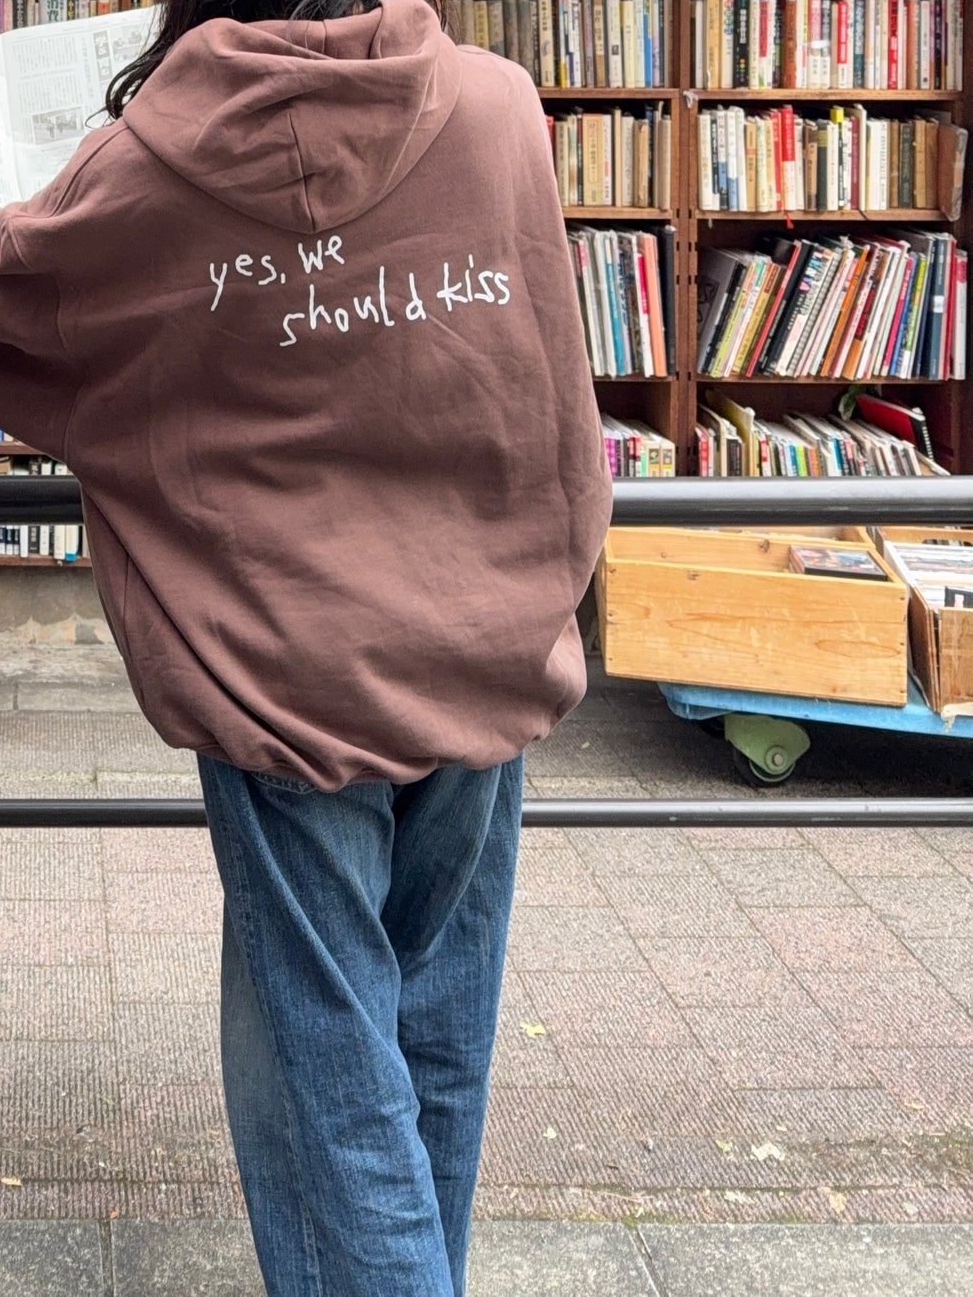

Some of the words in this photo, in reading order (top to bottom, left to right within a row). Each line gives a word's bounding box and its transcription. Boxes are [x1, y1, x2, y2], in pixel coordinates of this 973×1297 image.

[210, 253, 286, 312] yes,
[297, 235, 345, 274] we
[279, 265, 427, 347] should
[436, 253, 510, 312] kiss
